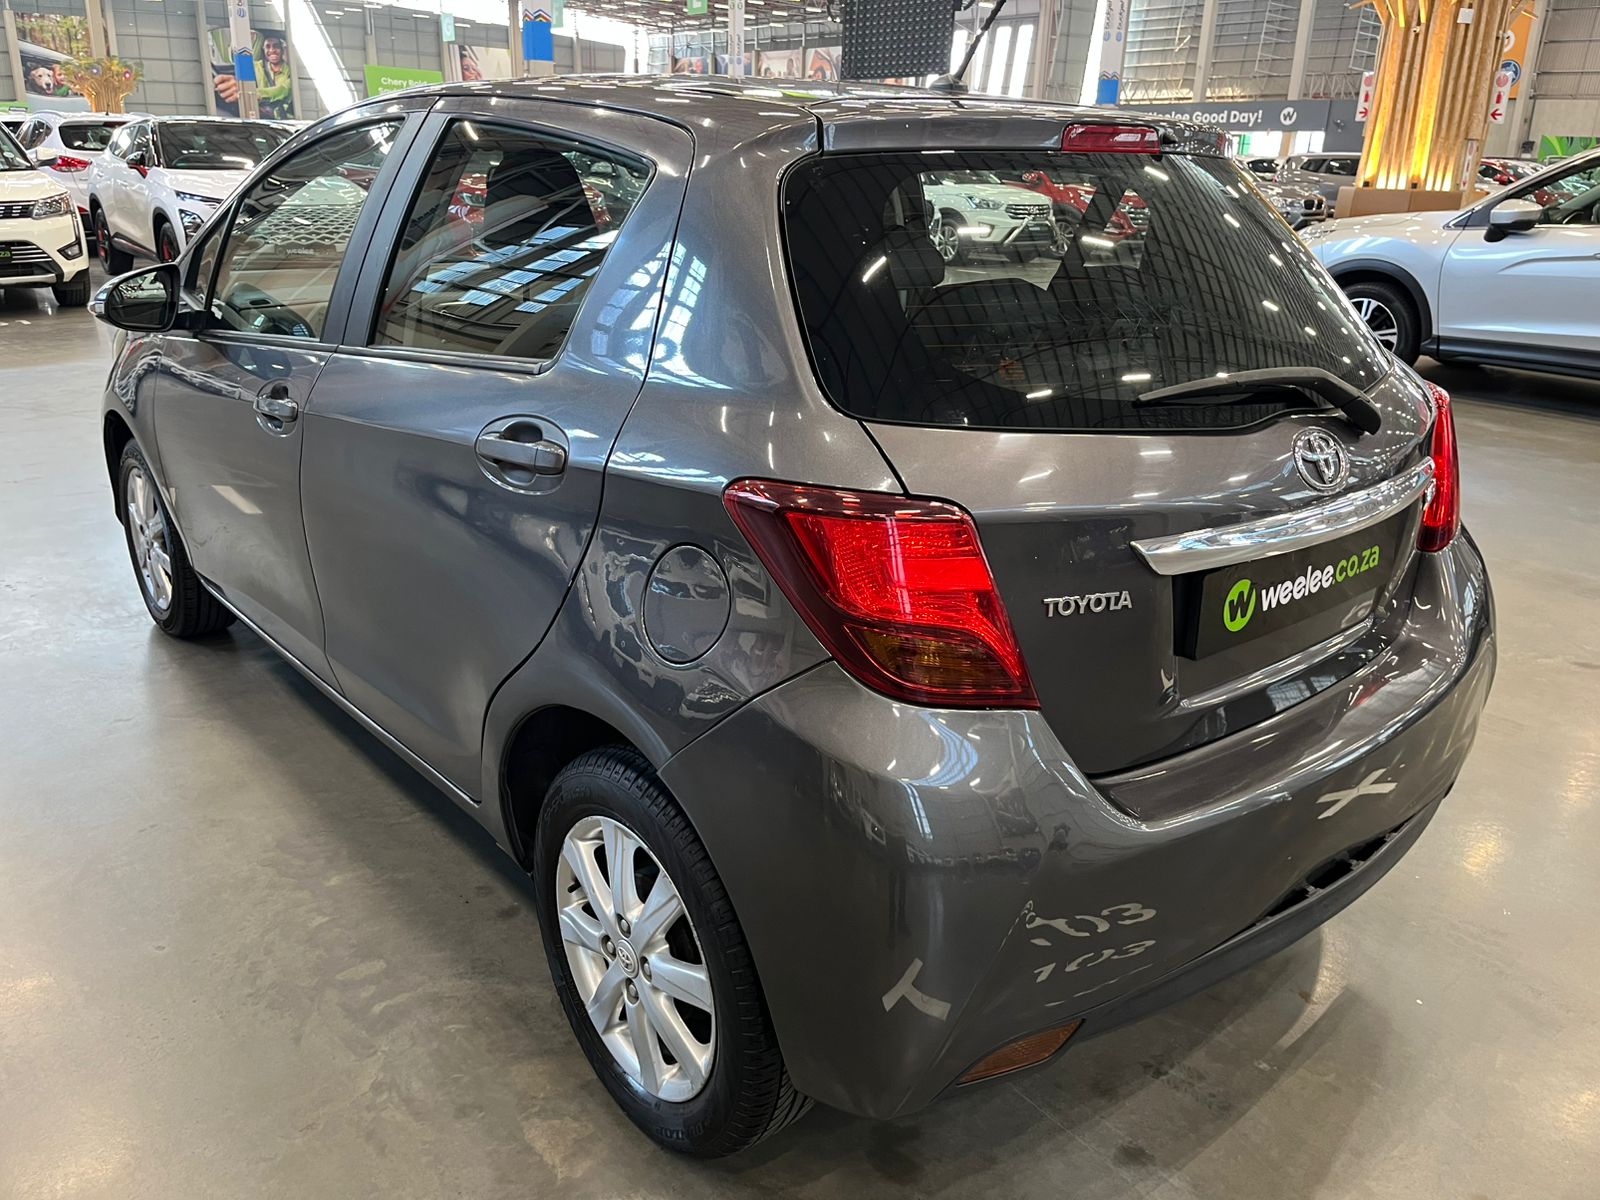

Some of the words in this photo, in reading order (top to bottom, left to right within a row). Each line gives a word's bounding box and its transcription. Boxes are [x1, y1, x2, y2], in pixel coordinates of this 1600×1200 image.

[380, 77, 408, 88] Chery
[1192, 110, 1228, 124] Good
[1230, 109, 1263, 127] Day!
[1261, 545, 1380, 611] weelee.co.za
[1043, 590, 1133, 618] TOYOTA
